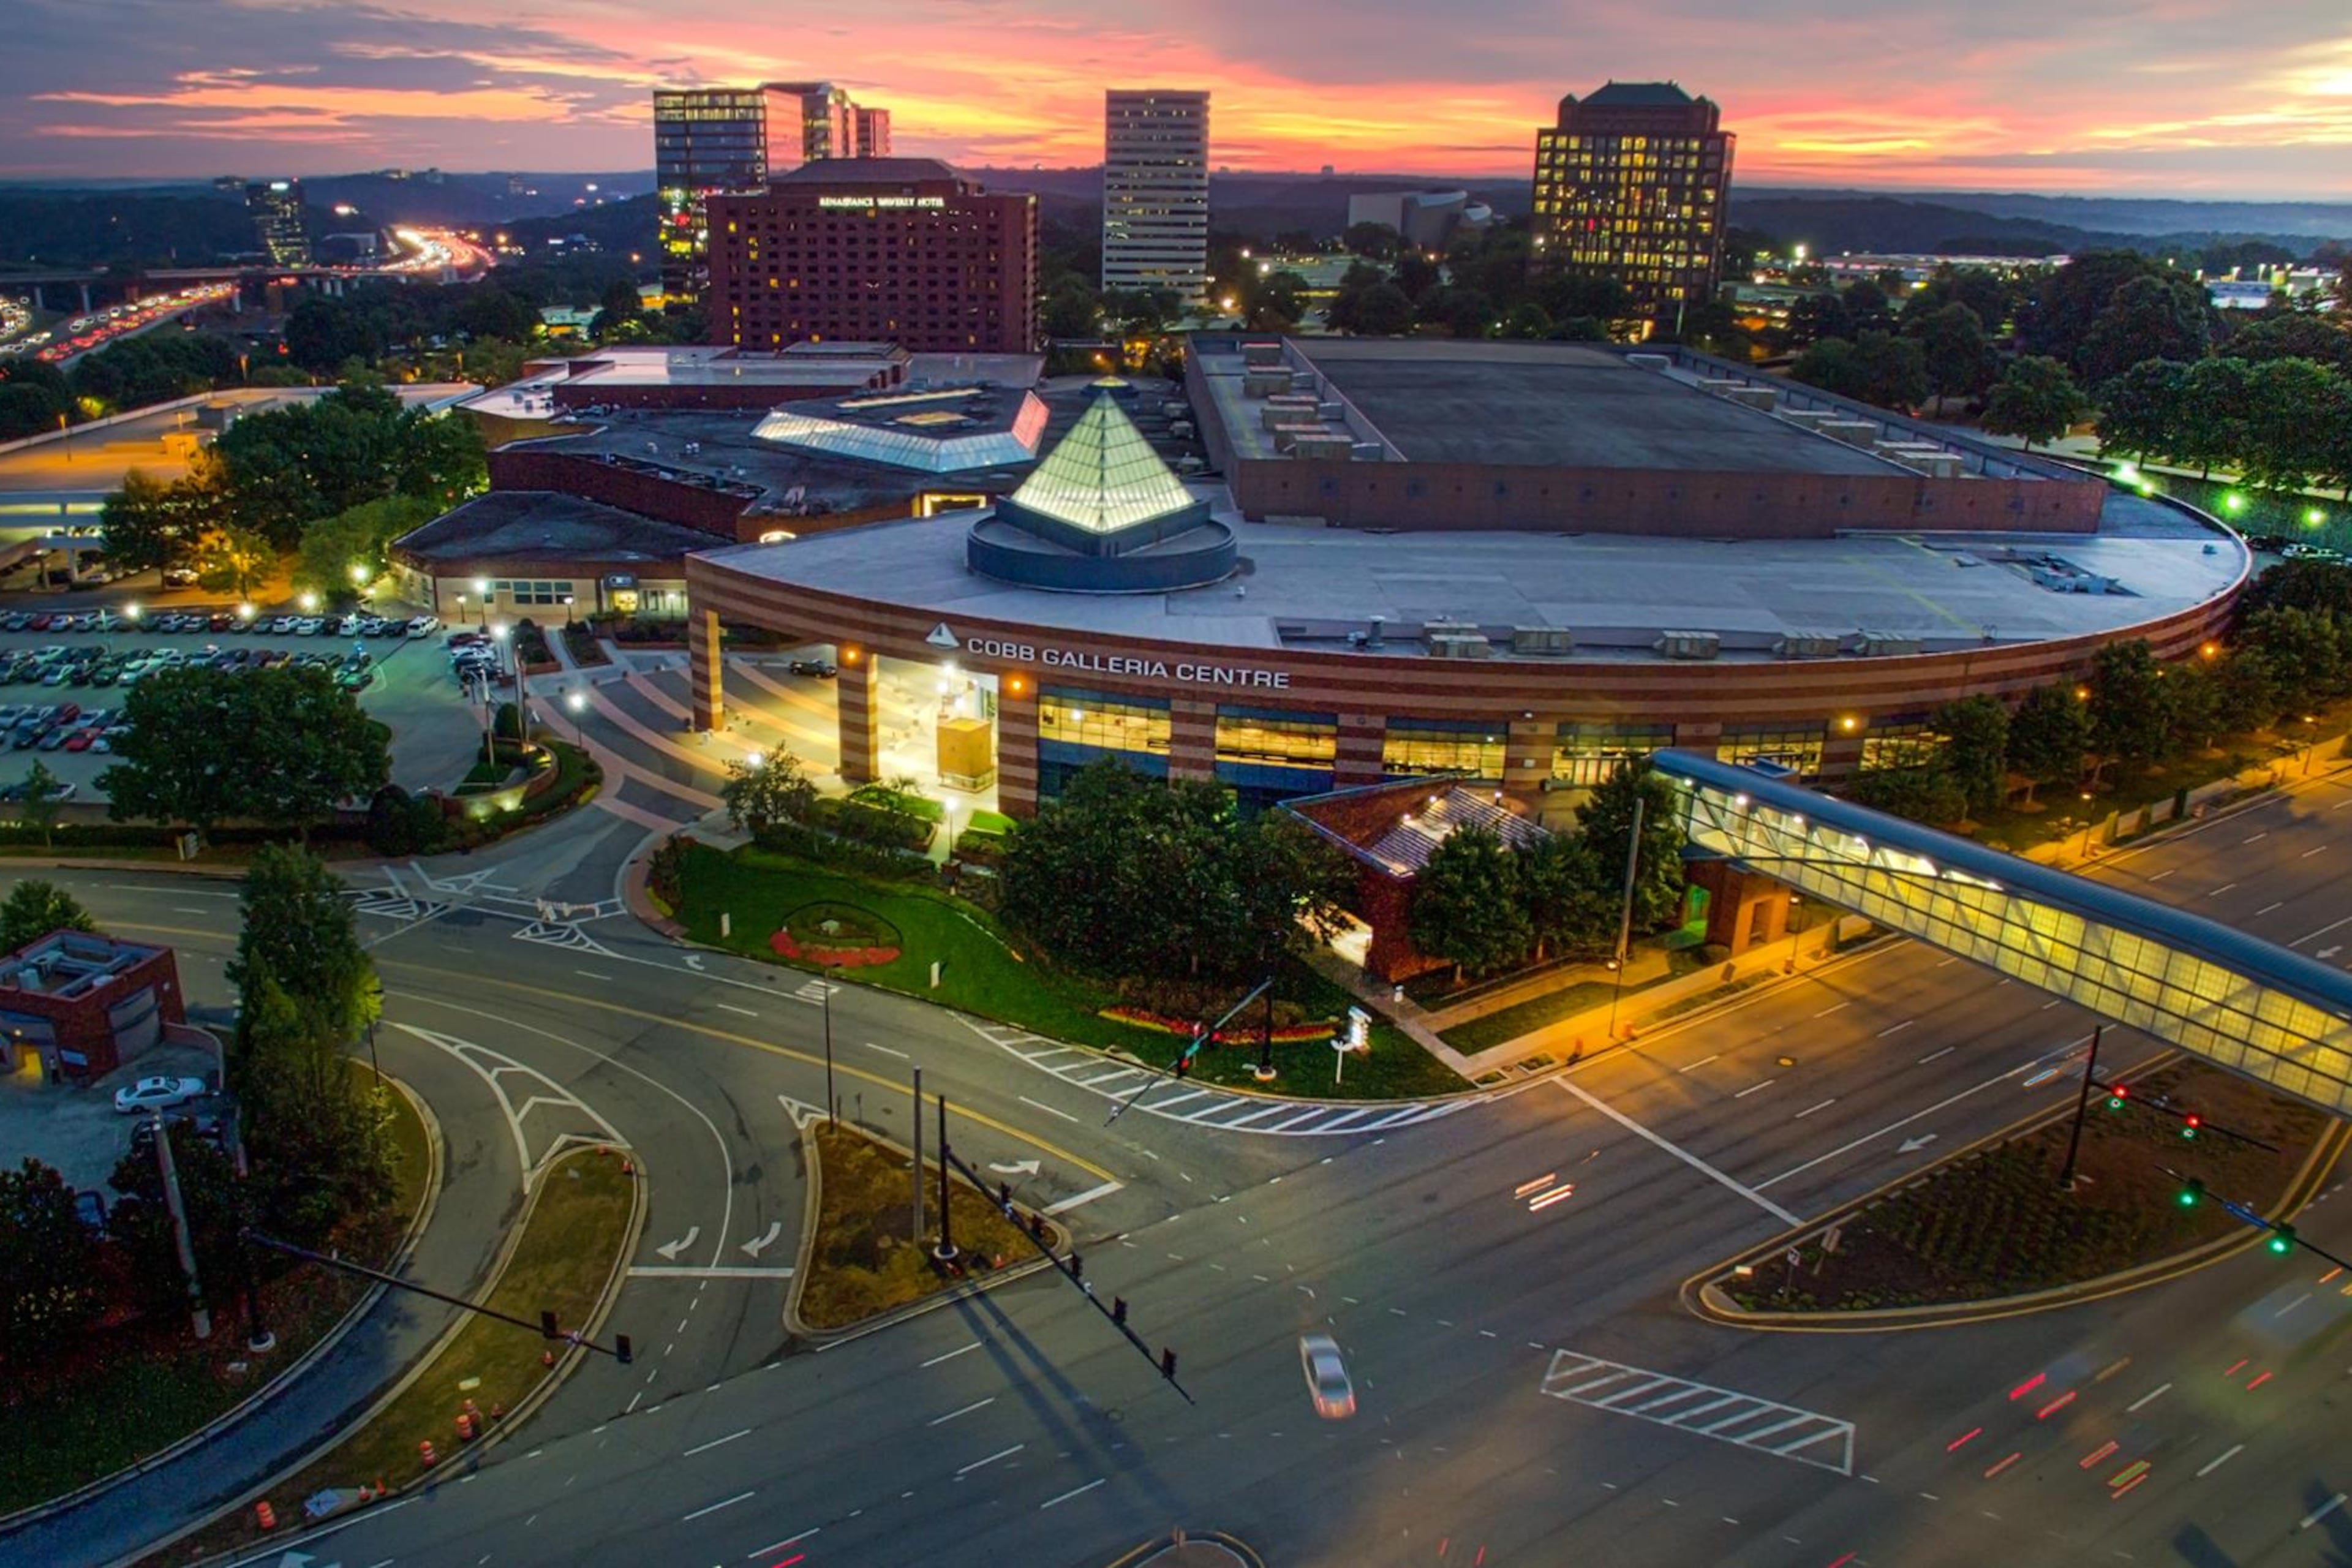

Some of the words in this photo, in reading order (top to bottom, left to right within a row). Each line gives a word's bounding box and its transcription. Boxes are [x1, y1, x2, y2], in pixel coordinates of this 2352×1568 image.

[967, 637, 1036, 662] COBB
[1042, 649, 1168, 678] GALLERIA
[1175, 663, 1290, 689] CENTRE
